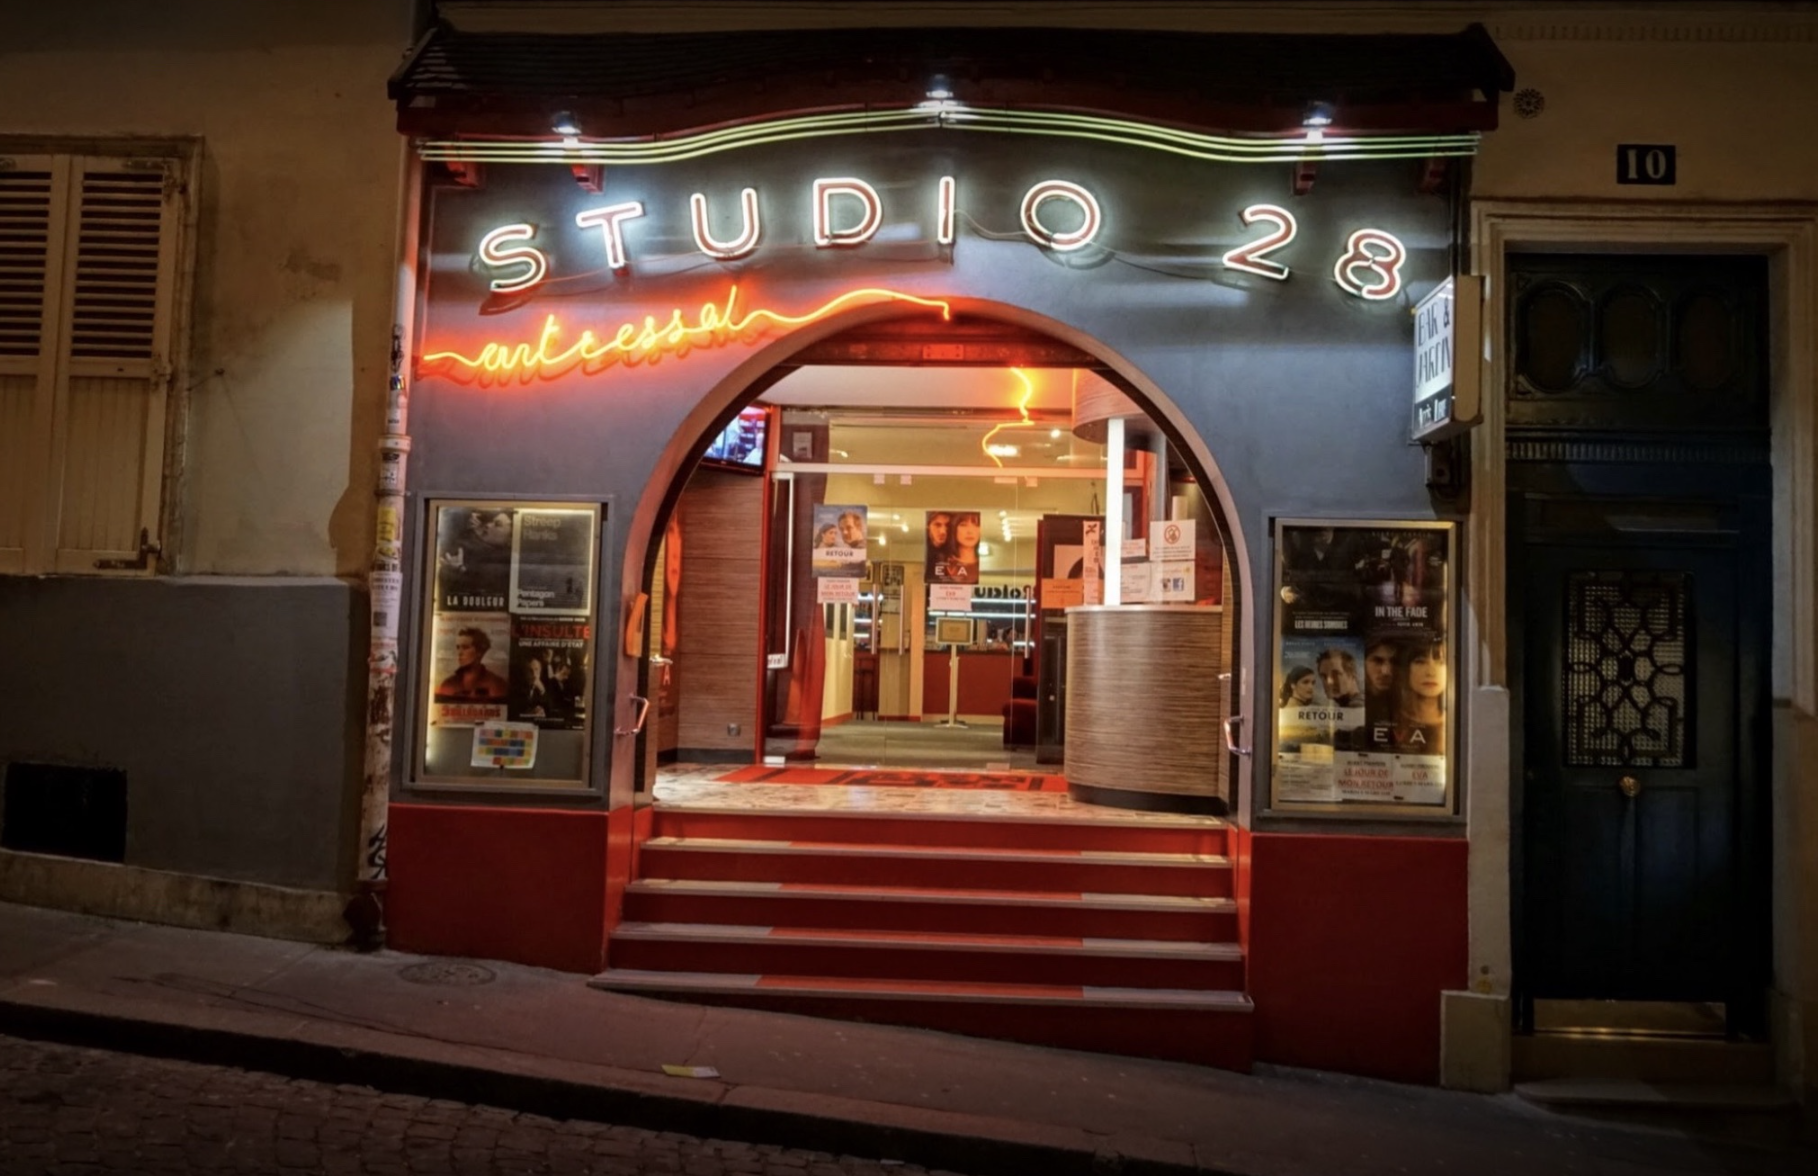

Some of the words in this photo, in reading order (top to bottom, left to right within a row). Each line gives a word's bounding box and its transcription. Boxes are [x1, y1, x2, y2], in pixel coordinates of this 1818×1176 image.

[1627, 149, 1666, 179] 10
[478, 175, 1101, 293] STUDIO
[1221, 204, 1406, 300] 28
[524, 515, 561, 529] Streep
[935, 566, 967, 576] EVA
[518, 589, 555, 600] Pentagon
[447, 595, 458, 606] LA
[463, 595, 504, 607] DOULEUR
[1375, 606, 1385, 617] IN
[1387, 606, 1403, 618] THE
[1405, 606, 1428, 618] FADE
[511, 624, 591, 640] L'INSULTE
[533, 640, 557, 648] AFFAIRE
[1298, 711, 1344, 721] RETOUR
[1374, 727, 1426, 744] EVA
[1412, 771, 1428, 780] EVA
[1338, 779, 1358, 788] MON
